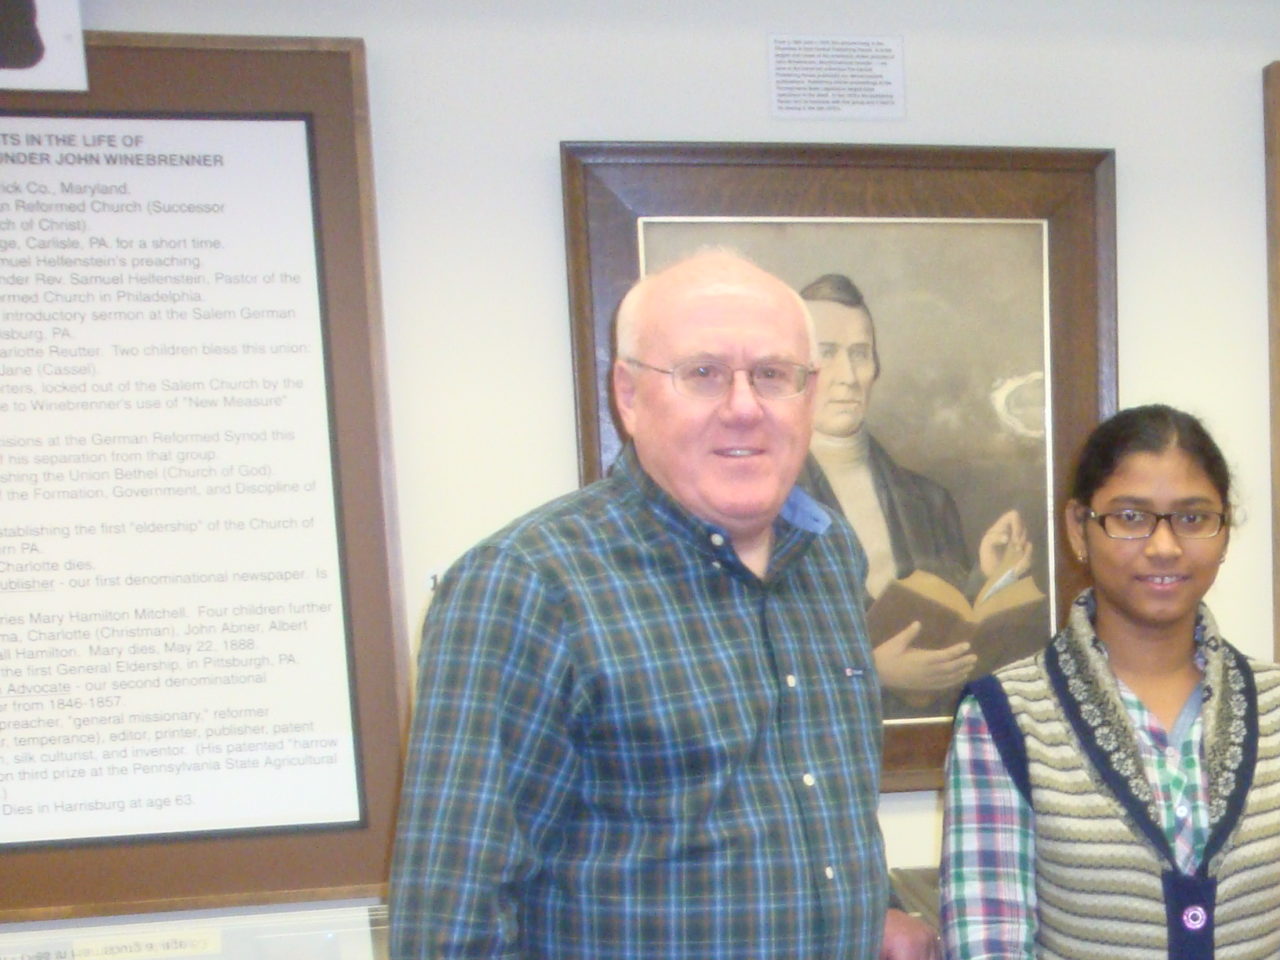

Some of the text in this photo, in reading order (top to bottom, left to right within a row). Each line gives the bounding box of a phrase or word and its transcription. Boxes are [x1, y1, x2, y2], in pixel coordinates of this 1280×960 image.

[24, 133, 42, 146] IN
[46, 133, 76, 146] THE
[82, 134, 116, 147] LIFE
[120, 134, 142, 148] OF
[54, 152, 100, 165] JOHN
[104, 152, 222, 166] WINEBRENNER
[14, 198, 224, 215] Reformed Church (Successor
[116, 236, 134, 249] for
[152, 237, 186, 249] short
[34, 254, 126, 267] Helfenstein's
[70, 271, 124, 285] Samuel
[214, 271, 256, 284] Pastor
[262, 272, 274, 284] of
[280, 271, 300, 284] the
[42, 290, 112, 303] Church in
[2, 306, 296, 324] introductory sermon the Salem German
[112, 342, 310, 356] Two children bless this union:
[40, 377, 304, 394] locked out of the Salem Church the
[12, 400, 26, 412] to
[30, 397, 132, 411] Winebrenner's
[136, 399, 162, 409] use
[164, 396, 178, 408] of
[46, 428, 294, 446] at the German Reformed Synod this
[8, 449, 172, 466] his separation from that
[42, 464, 234, 482] the Union Bethel (Church of
[6, 479, 316, 501] the and Discipline of
[74, 524, 96, 535] the
[100, 521, 126, 534] first
[206, 519, 220, 531] of
[224, 518, 244, 531] the
[248, 516, 298, 530] Church
[302, 516, 314, 528] of
[68, 577, 90, 588] our
[94, 574, 120, 587] first
[124, 571, 228, 586] denominational
[314, 567, 328, 579] Is
[28, 611, 64, 627] Mary
[68, 608, 130, 623] Hamilton
[196, 604, 228, 618] Four
[232, 602, 284, 616] children
[288, 600, 332, 614] further
[26, 626, 90, 642] Charlotte
[184, 622, 216, 636] John
[268, 618, 308, 632] Albert
[88, 643, 122, 659] Mary
[164, 640, 192, 655] May
[26, 663, 52, 677] first
[56, 660, 110, 675] General
[186, 657, 198, 669] in
[6, 671, 266, 695] Advocate our second denominational
[10, 699, 44, 712] from
[212, 704, 270, 720] reformer
[272, 720, 314, 735] patent
[14, 752, 34, 764] silk
[102, 746, 128, 759] and
[194, 741, 222, 756] (His
[226, 739, 284, 755] patented
[18, 751, 338, 781] third prize at the Pennsylvania State Agricultural
[2, 802, 32, 816] Dies
[36, 802, 50, 813] in
[128, 797, 142, 808] at
[146, 796, 170, 810] age
